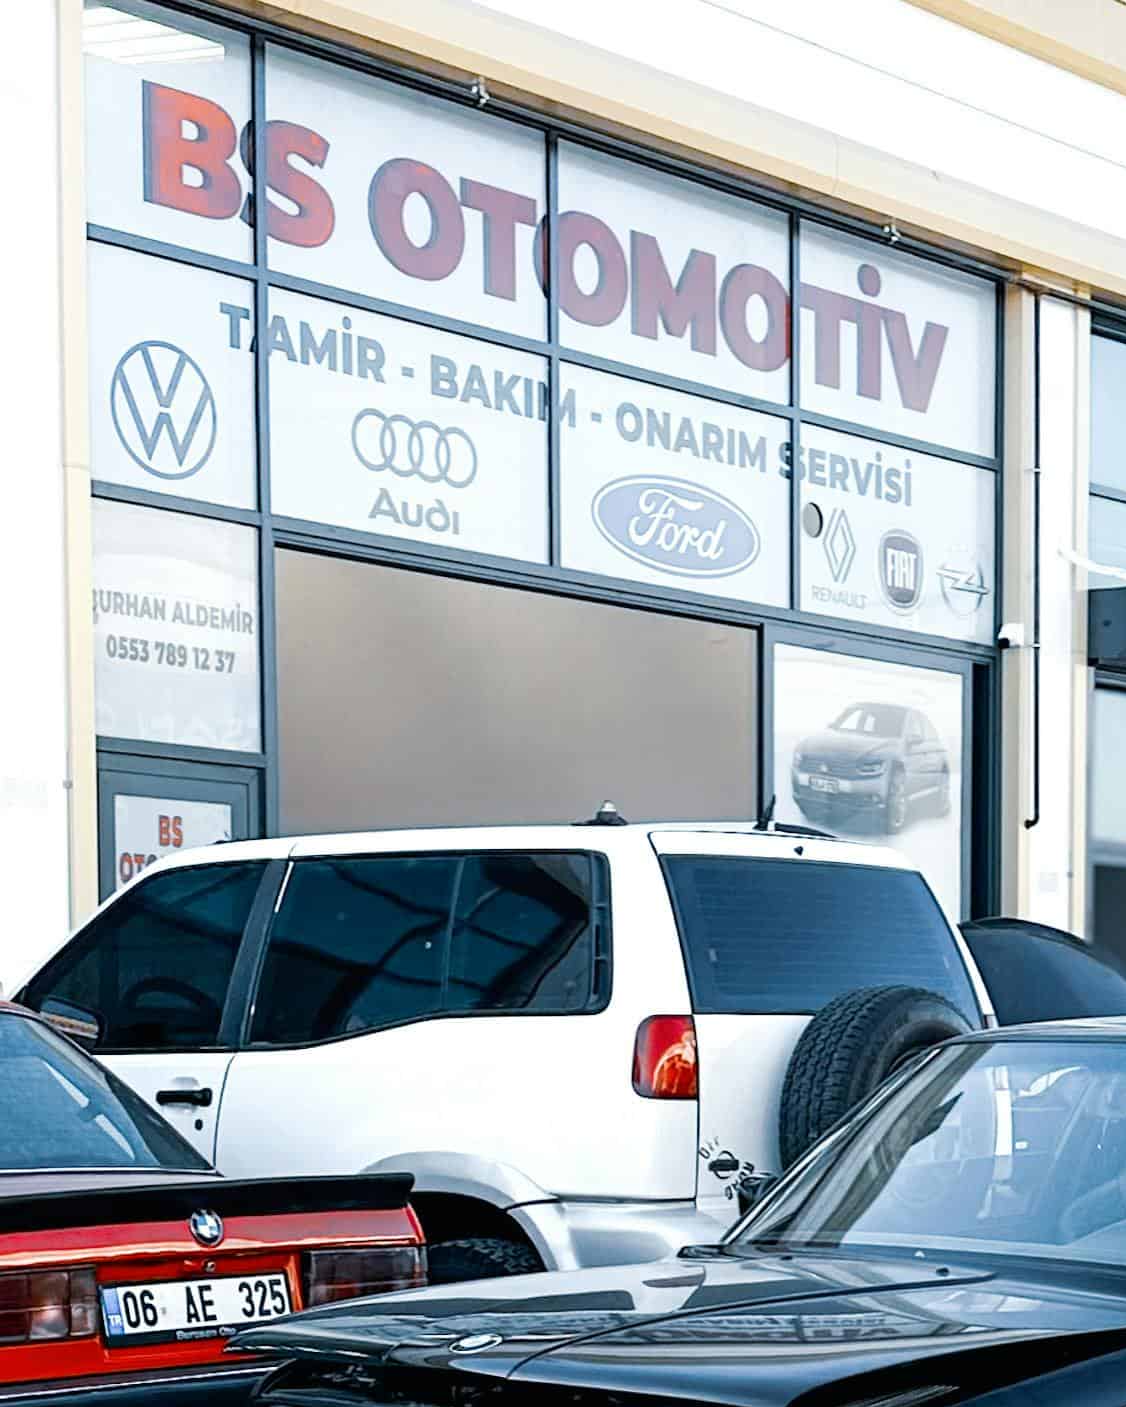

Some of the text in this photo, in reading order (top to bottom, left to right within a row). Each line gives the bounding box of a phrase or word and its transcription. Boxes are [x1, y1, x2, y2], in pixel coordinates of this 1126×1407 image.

[143, 80, 949, 413] BS OTOMOTİV
[616, 402, 767, 473] ONARIM
[628, 488, 728, 561] Ford
[106, 634, 236, 674] 0553 789 12 37
[158, 814, 184, 848] BS
[123, 1278, 286, 1328] 06 AE 325
